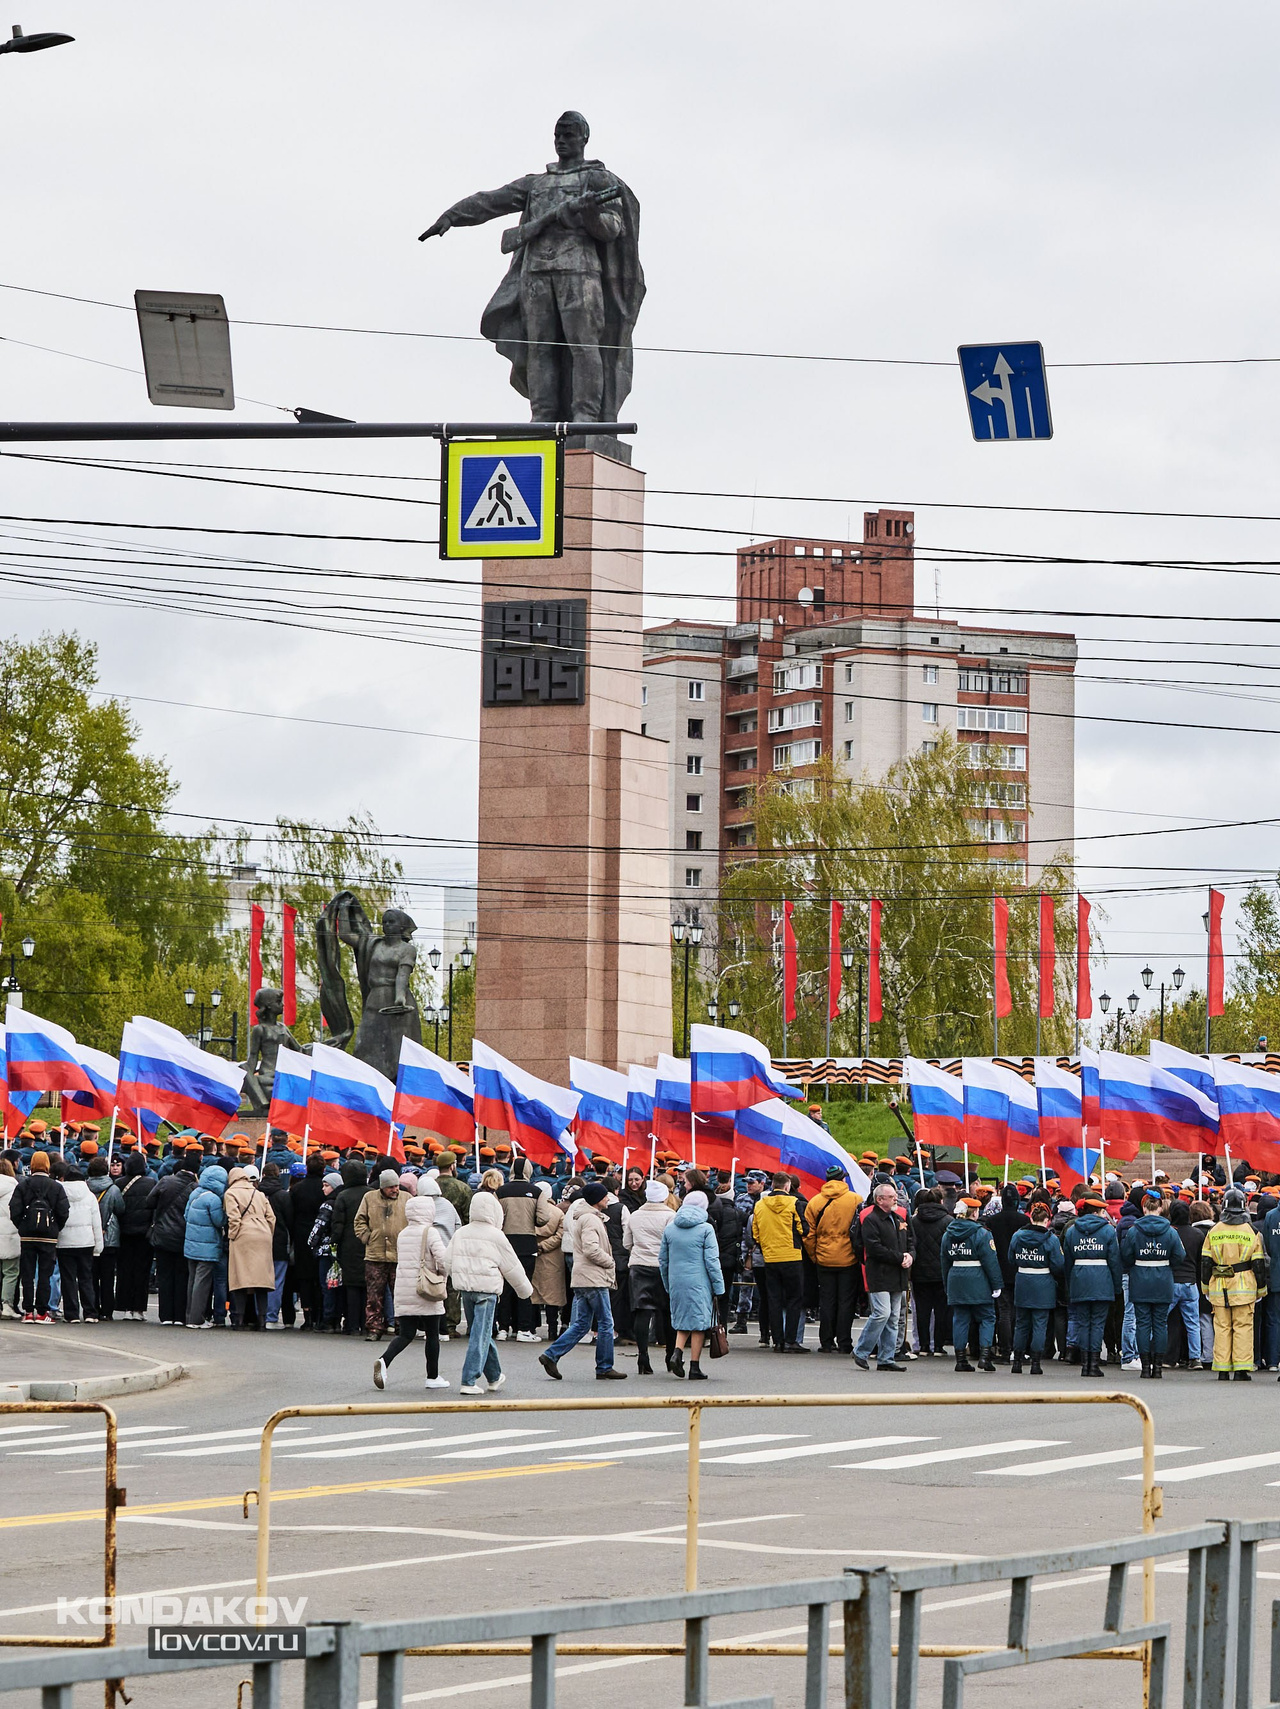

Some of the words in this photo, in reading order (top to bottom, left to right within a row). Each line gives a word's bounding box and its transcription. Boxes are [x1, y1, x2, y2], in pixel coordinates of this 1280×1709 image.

[491, 605, 572, 648] 1941
[484, 656, 579, 702] 1945
[1015, 1253, 1045, 1262] РОССИИ
[1073, 1244, 1104, 1252] РОССИИ
